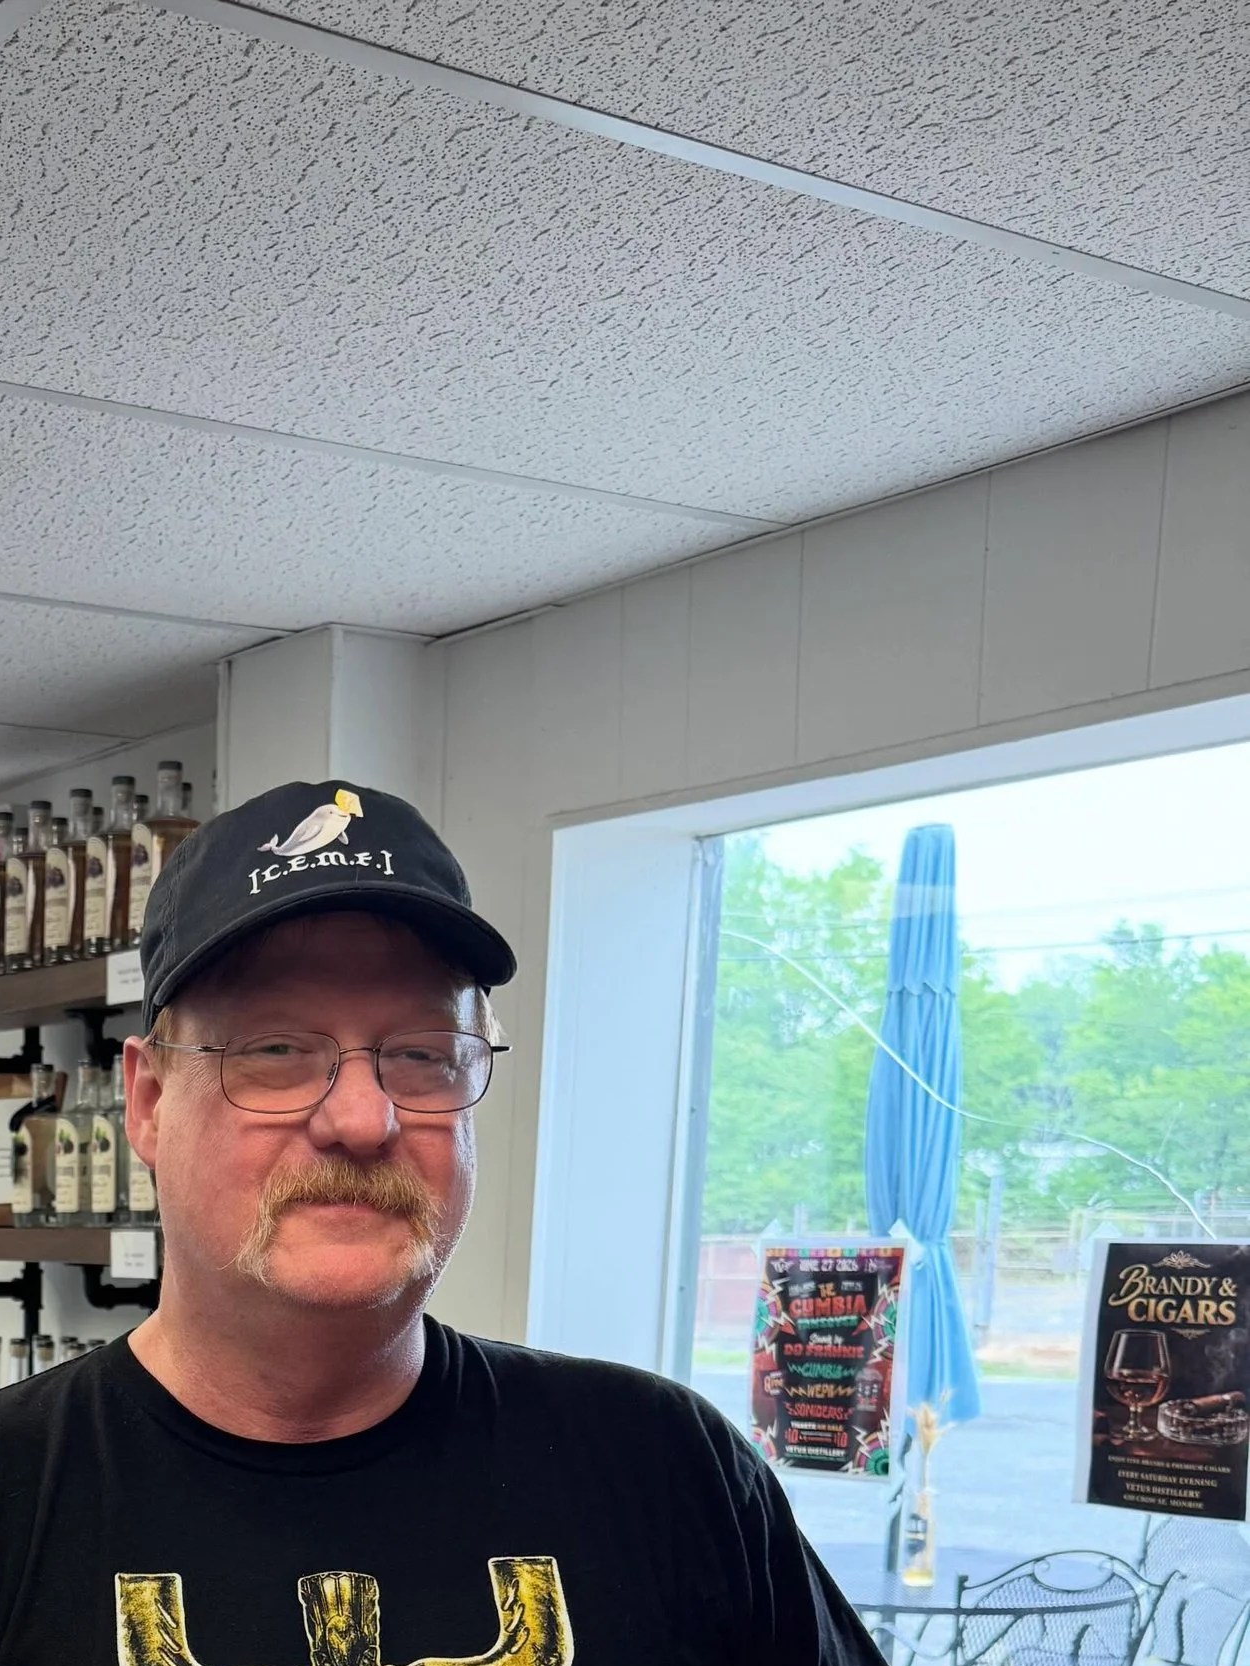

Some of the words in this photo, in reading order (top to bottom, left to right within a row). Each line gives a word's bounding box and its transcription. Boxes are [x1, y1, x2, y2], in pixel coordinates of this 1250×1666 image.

[1108, 1263, 1217, 1306] BRANDY
[1218, 1277, 1237, 1297] &
[788, 1295, 867, 1317] CUMBIA
[1127, 1298, 1237, 1326] CIGARS
[1152, 1485, 1201, 1499] DISTILLERY
[1179, 1476, 1218, 1488] EVENING
